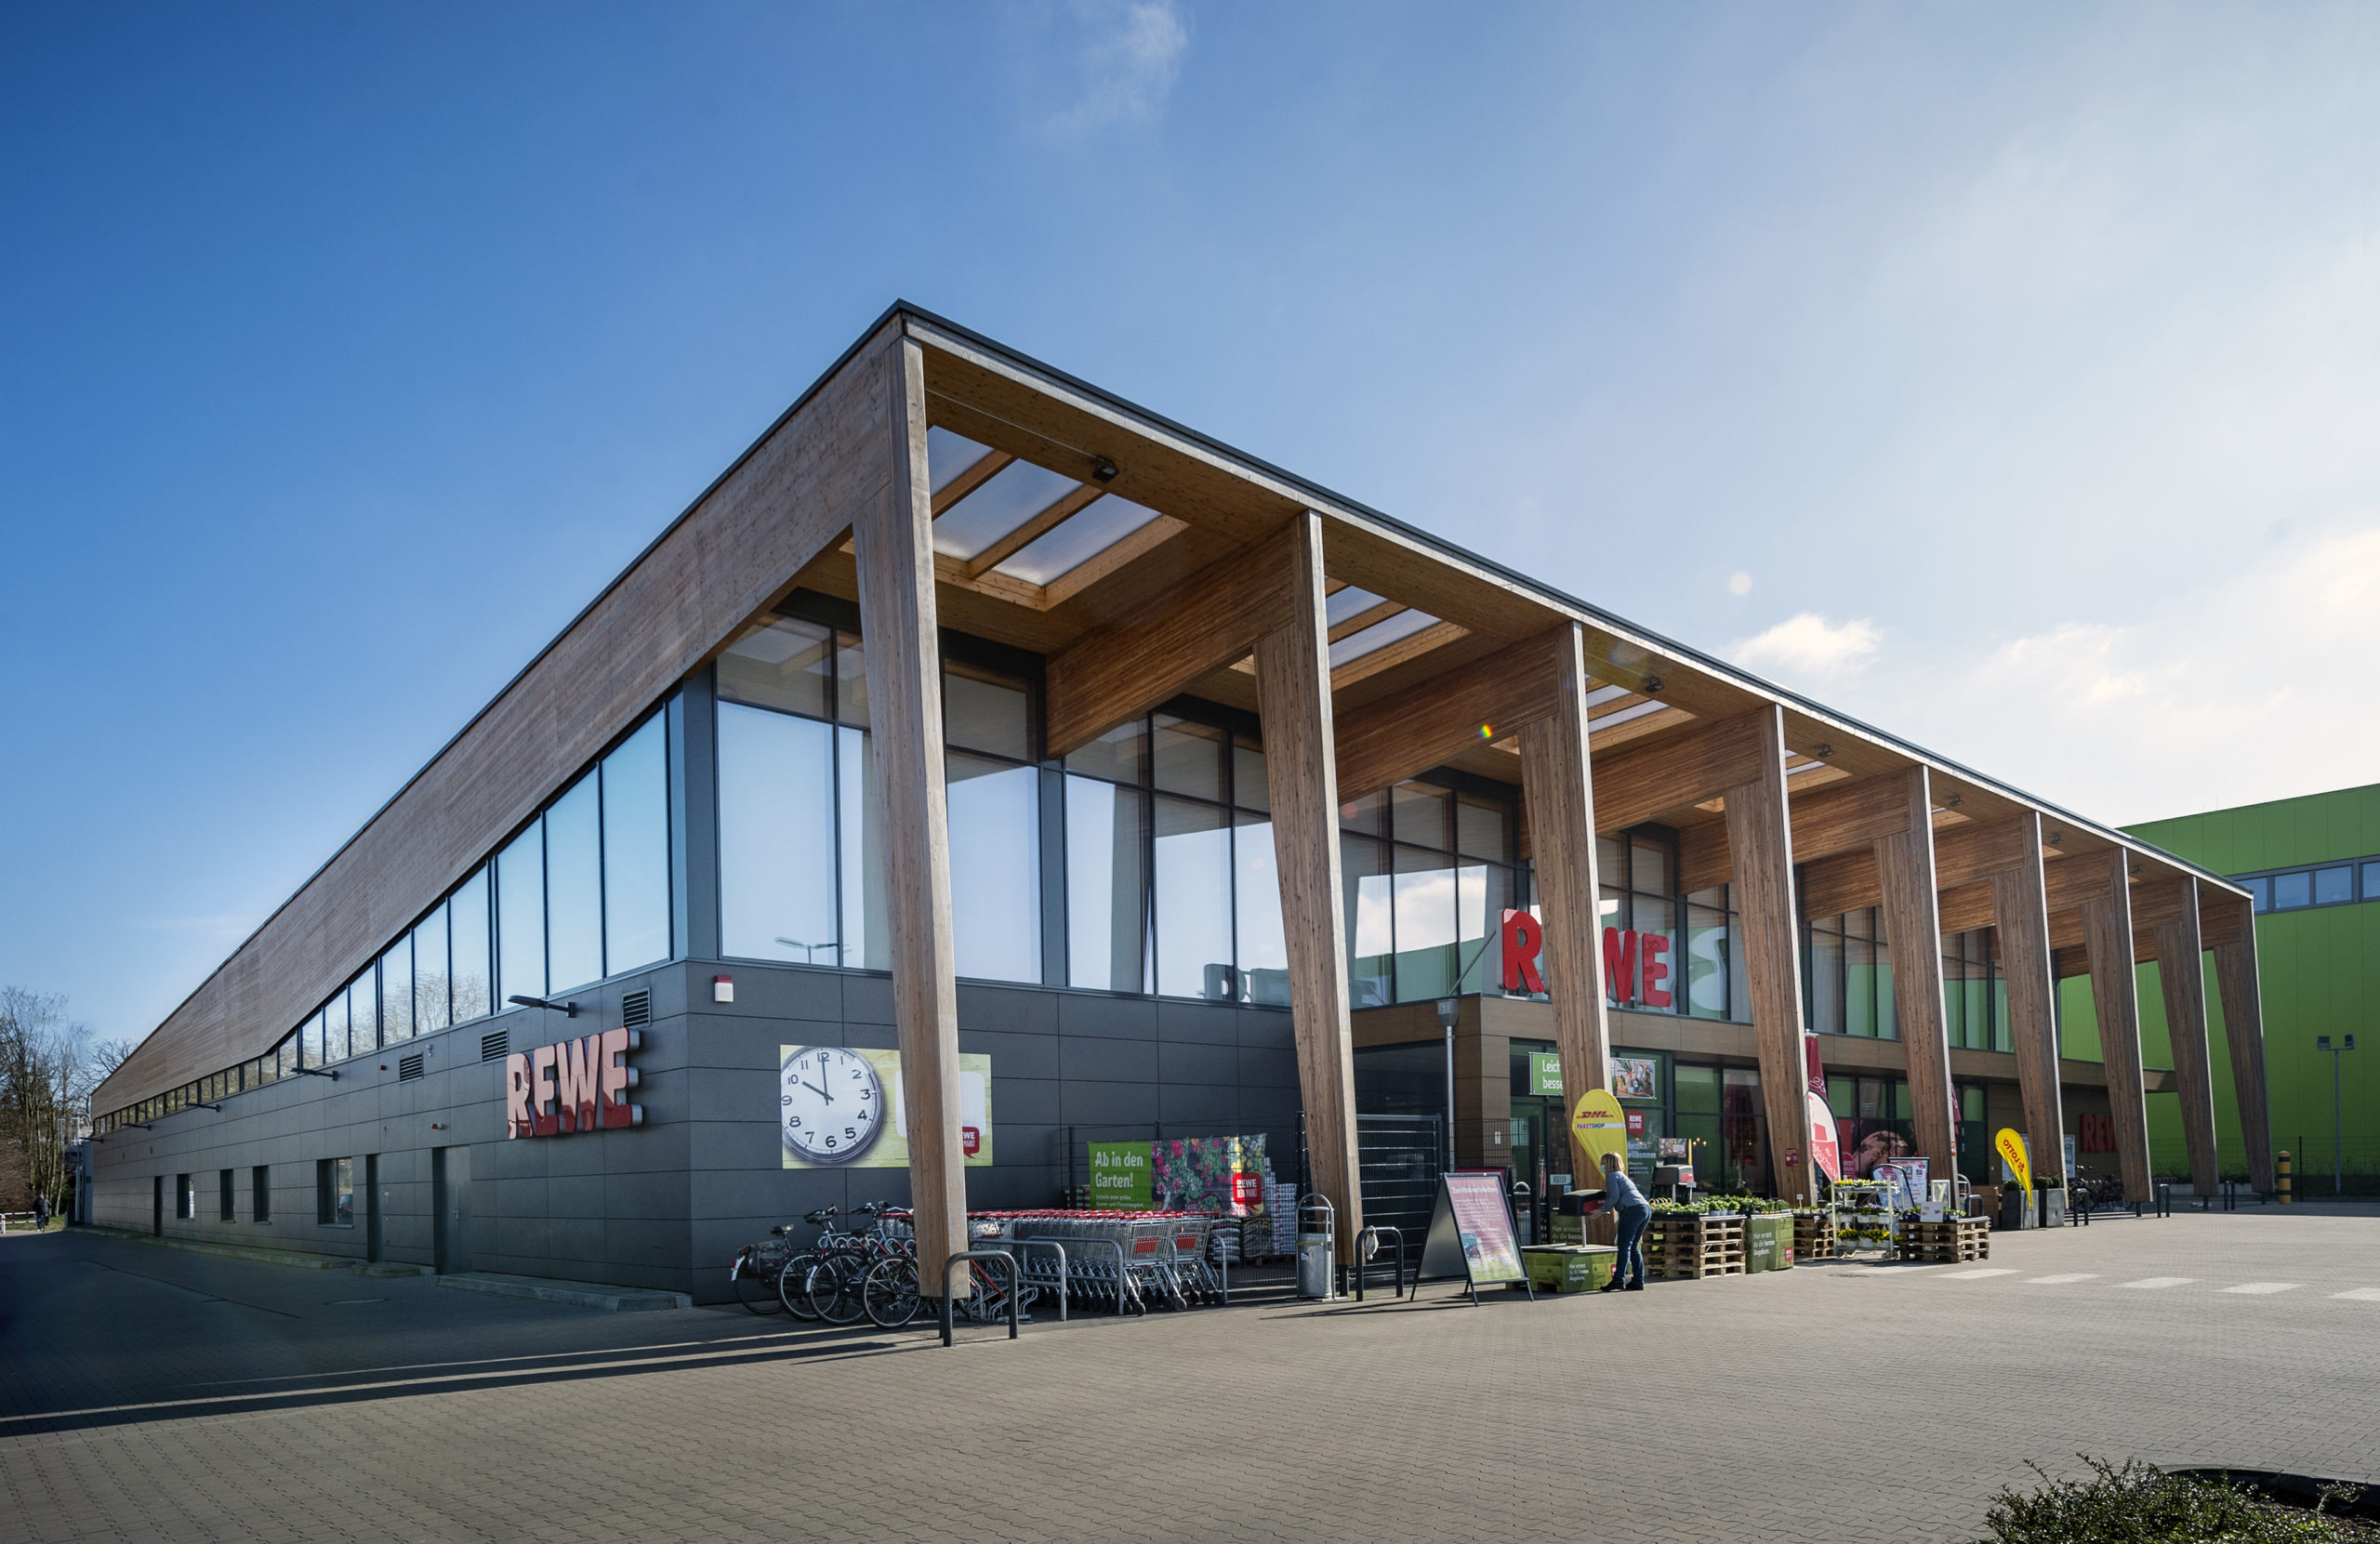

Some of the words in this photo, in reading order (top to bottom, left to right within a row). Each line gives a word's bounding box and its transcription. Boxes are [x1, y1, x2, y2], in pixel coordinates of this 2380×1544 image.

[1501, 908, 1672, 1008] RWE
[817, 1052, 830, 1062] 12
[840, 1055, 844, 1065] 1
[800, 1060, 809, 1070] 11
[787, 1074, 799, 1085] 10
[852, 1069, 863, 1079] 2
[507, 1027, 638, 1140] REWE
[860, 1089, 871, 1100] 3
[781, 1095, 792, 1106] 9
[857, 1109, 868, 1121] 4
[1580, 1110, 1609, 1119] DHL
[788, 1115, 801, 1128] 8
[804, 1131, 815, 1143] 7
[844, 1127, 857, 1140] 5
[962, 1131, 975, 1140] WE
[825, 1135, 837, 1148] 6
[1095, 1151, 1110, 1168] Ab
[1111, 1151, 1122, 1168] in
[1123, 1150, 1144, 1168] den
[1095, 1171, 1134, 1189] Garten!
[1236, 1179, 1257, 1189] REWE
